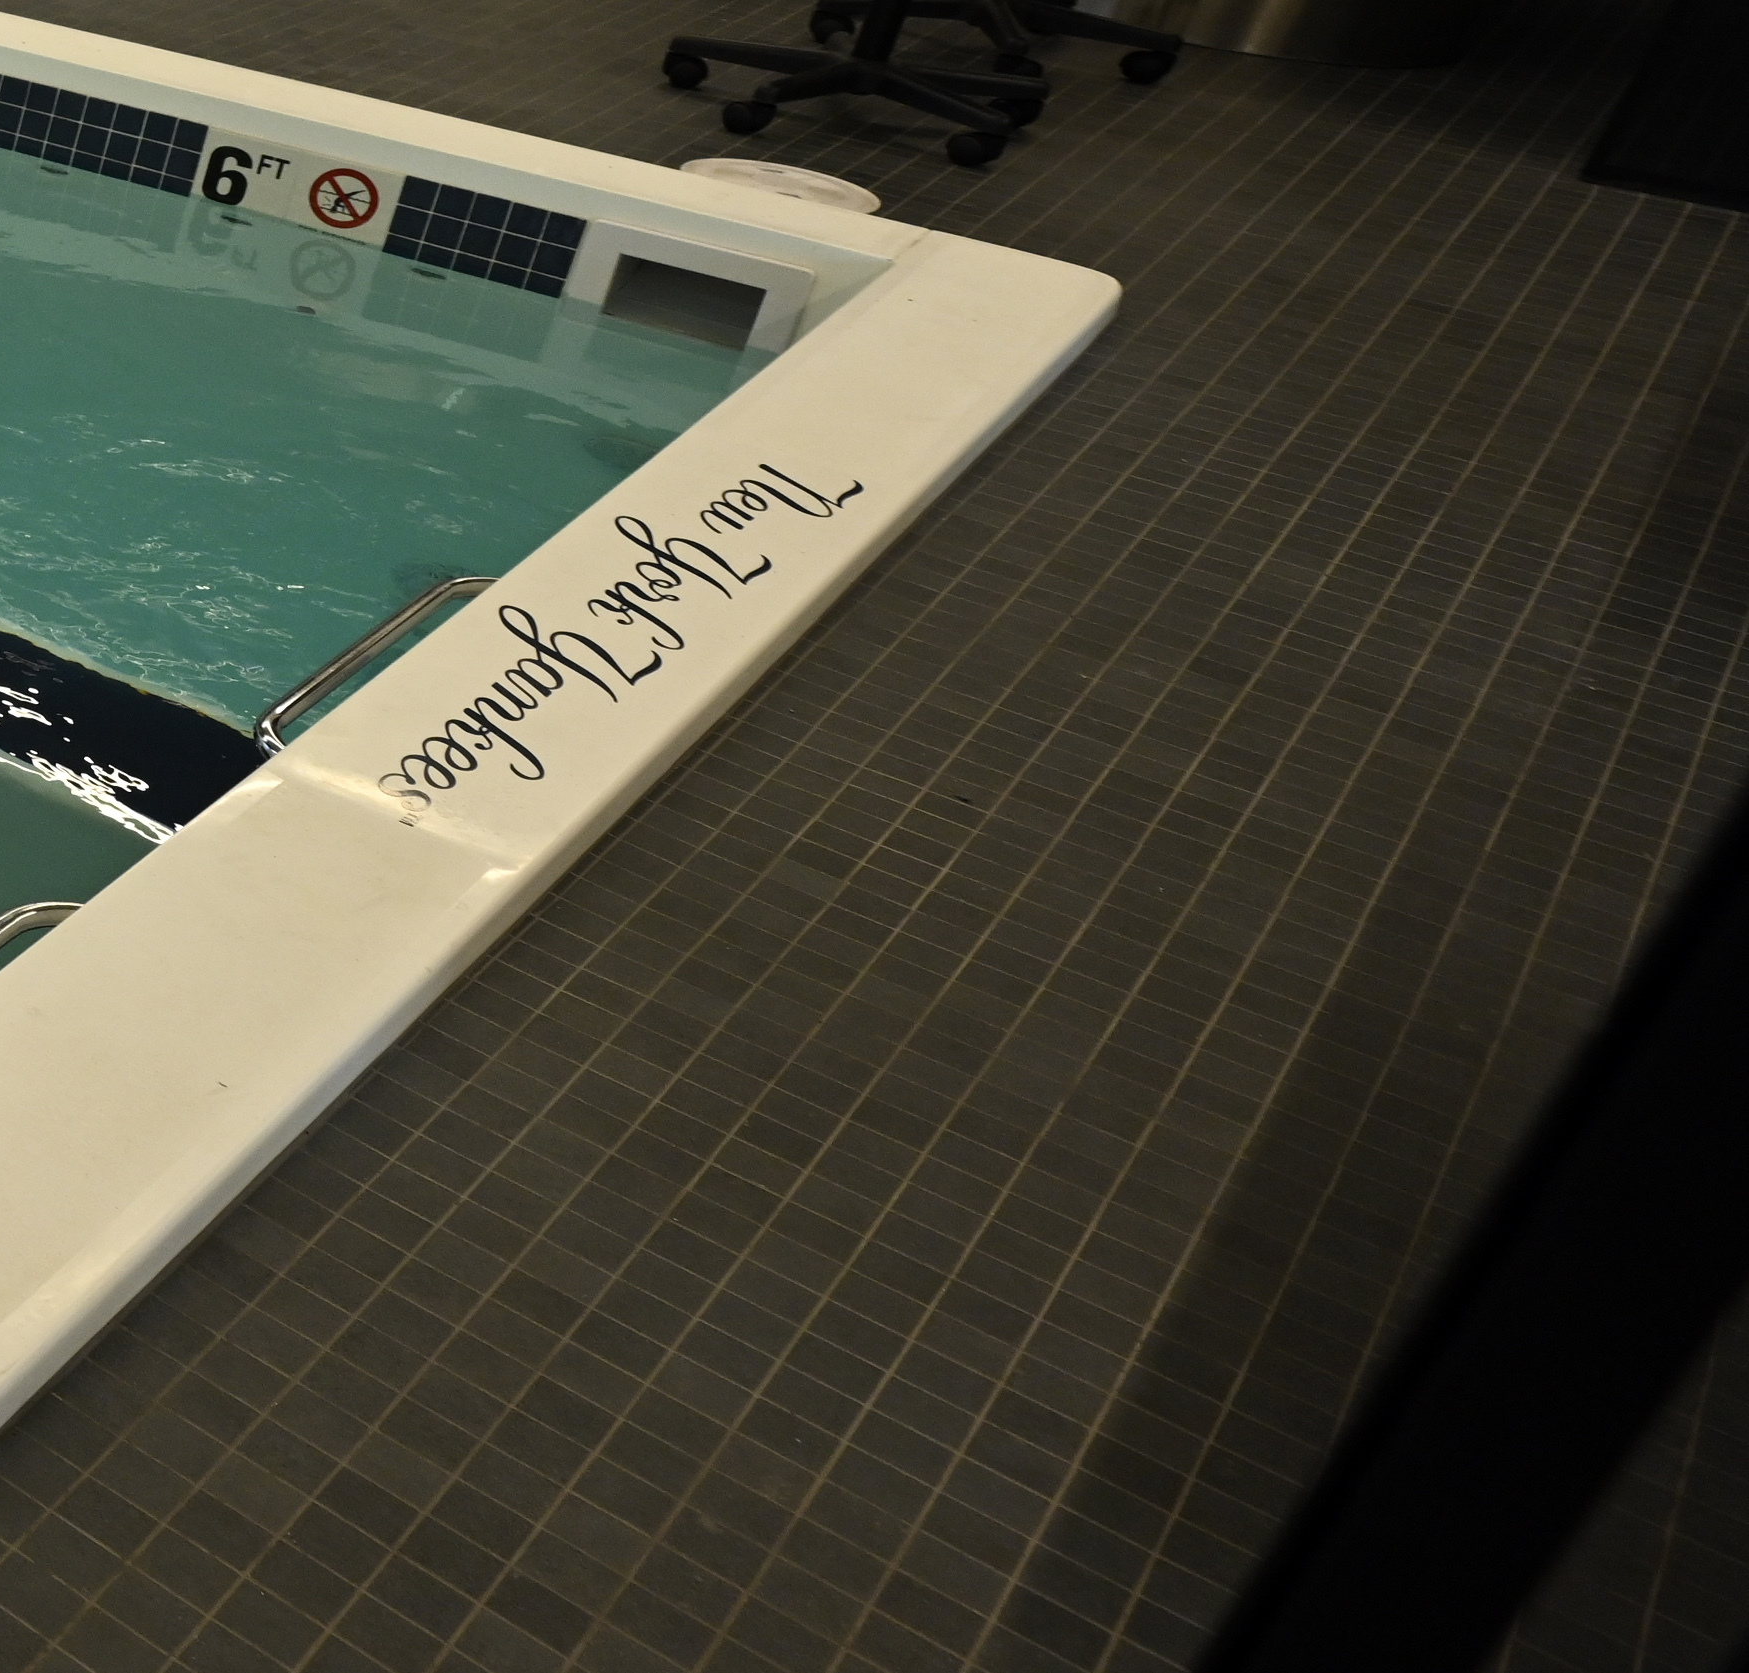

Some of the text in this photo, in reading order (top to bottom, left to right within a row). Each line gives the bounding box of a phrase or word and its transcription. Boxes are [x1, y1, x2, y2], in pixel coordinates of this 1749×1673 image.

[202, 145, 291, 206] 6 FT
[377, 463, 864, 813] New York Yankees
